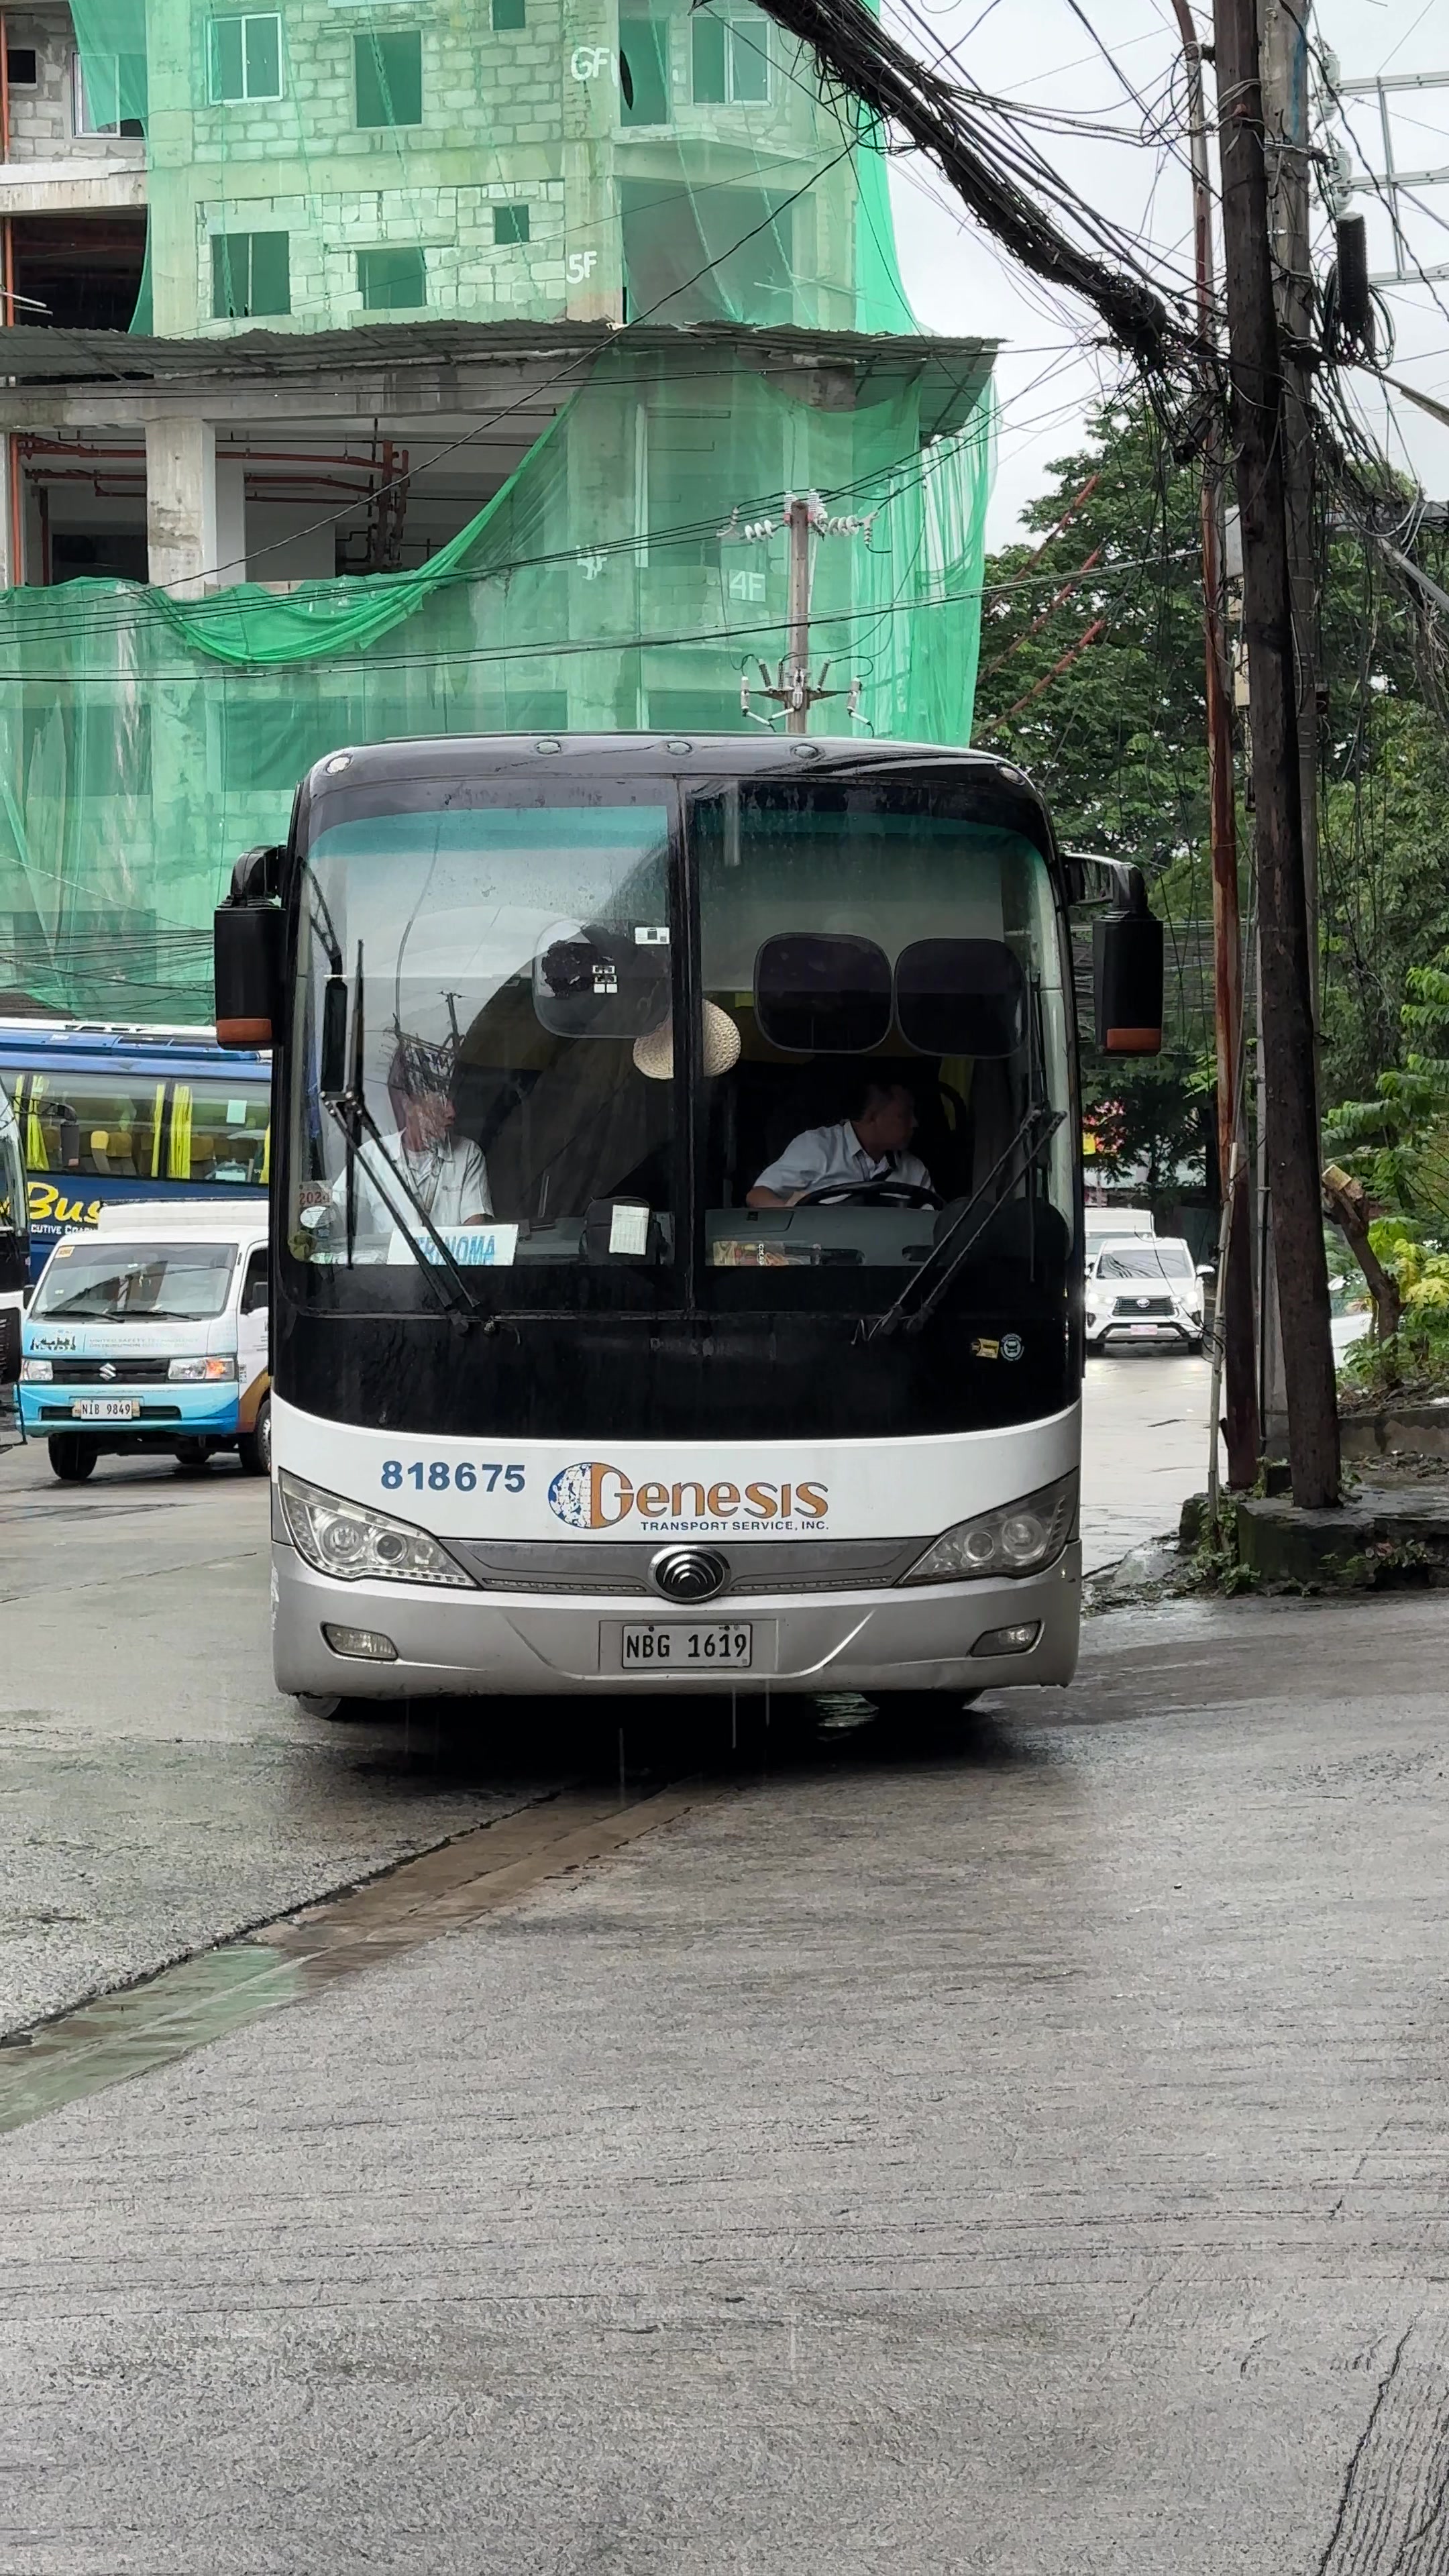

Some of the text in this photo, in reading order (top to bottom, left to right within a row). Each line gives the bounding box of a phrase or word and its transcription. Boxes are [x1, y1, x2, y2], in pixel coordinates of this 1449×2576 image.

[566, 250, 597, 284] 5F
[729, 571, 765, 601] 4F
[28, 1181, 100, 1224] Bus
[30, 1224, 62, 1234] CUTIVE
[82, 1404, 131, 1415] NIB 9849
[380, 1460, 525, 1493] 818675
[641, 1520, 829, 1532] TRANSPORT SERVICE, INC.
[627, 1633, 747, 1658] NBG 1619
